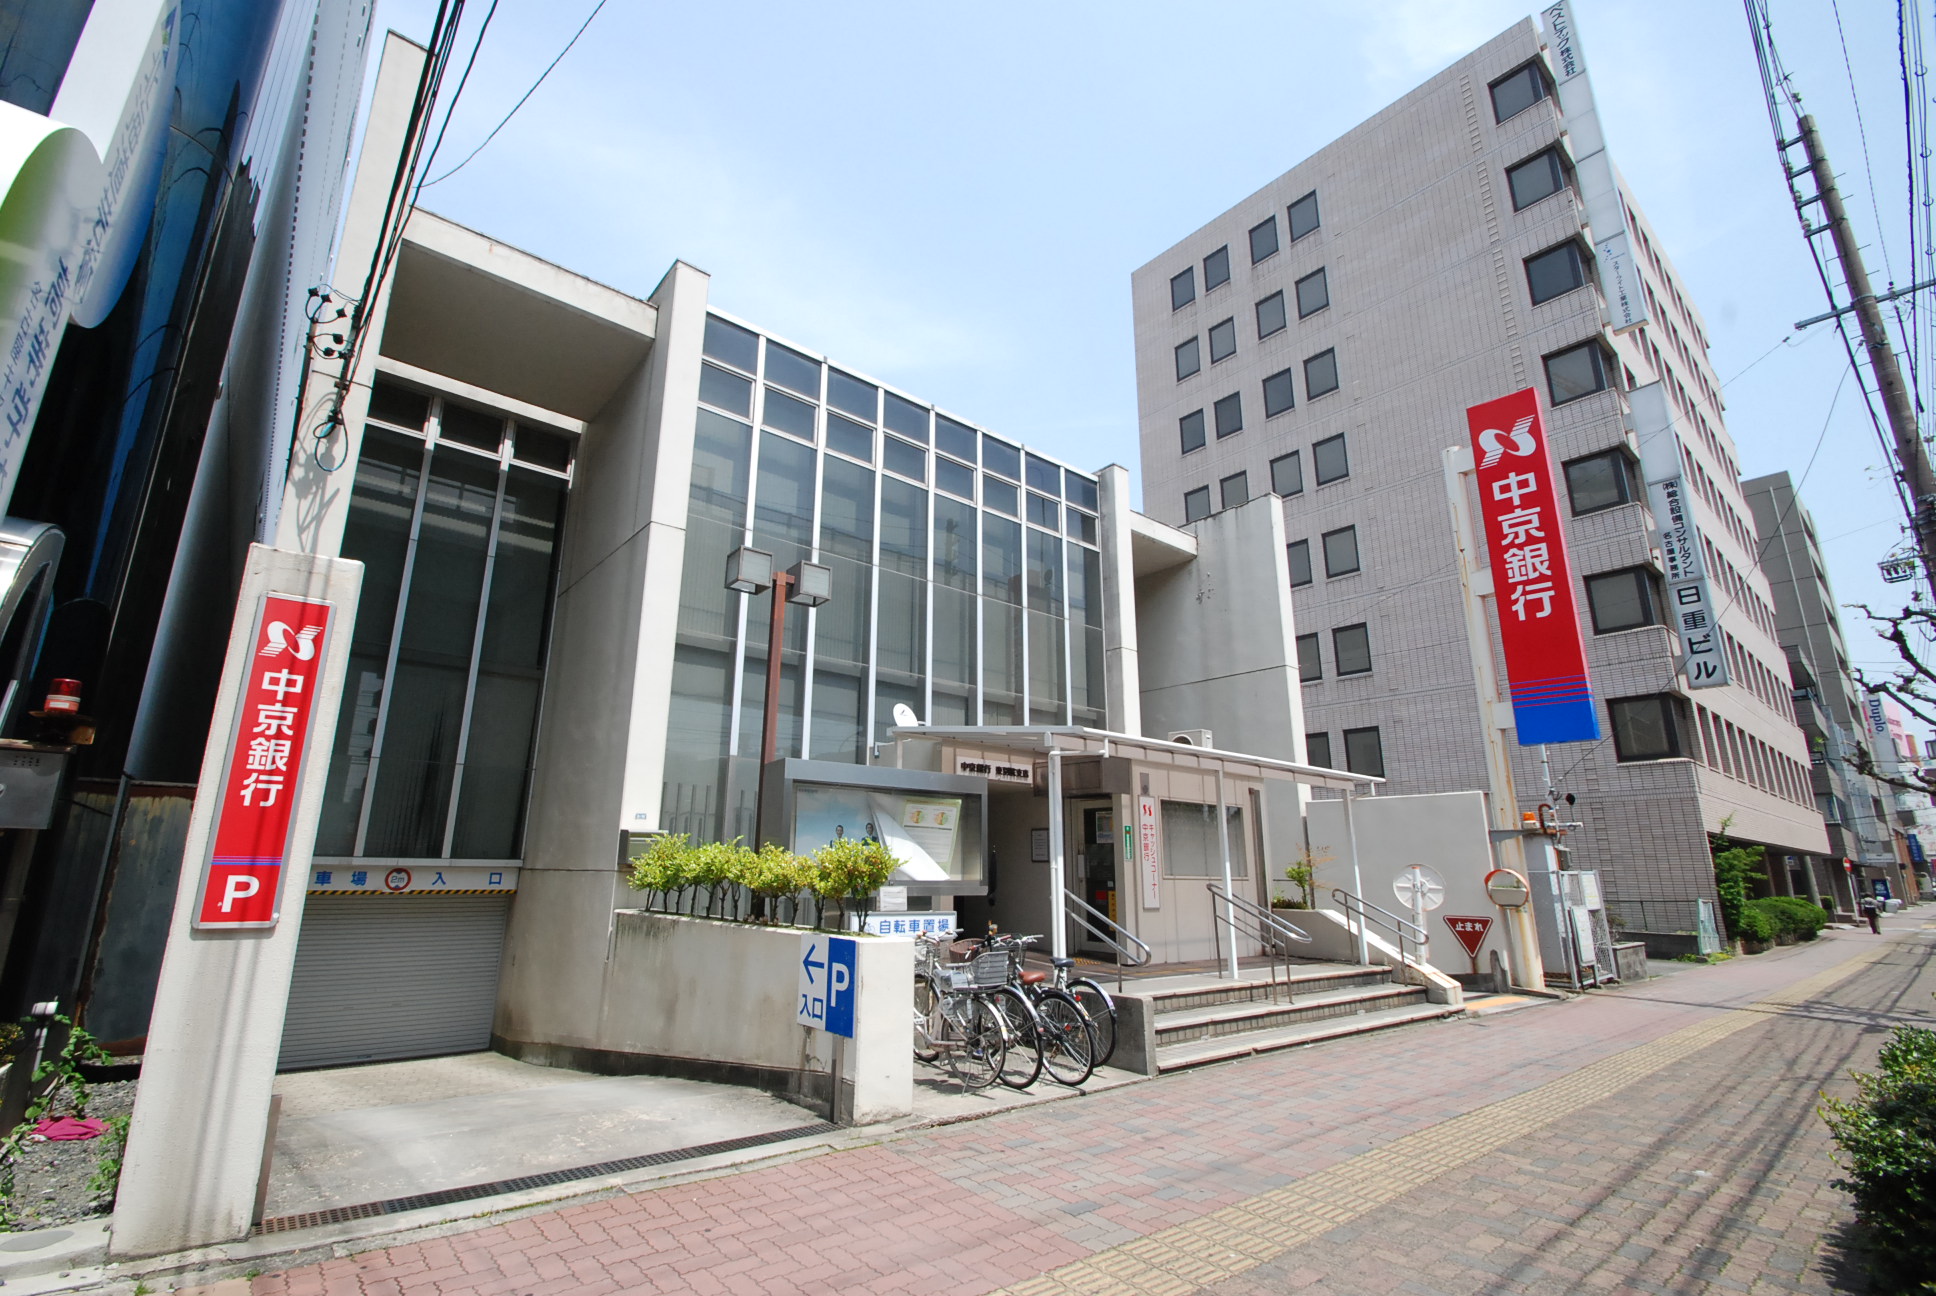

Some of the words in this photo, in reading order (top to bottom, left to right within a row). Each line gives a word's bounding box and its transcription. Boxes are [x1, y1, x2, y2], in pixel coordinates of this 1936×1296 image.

[1491, 471, 1556, 621] 中京銀行
[1663, 532, 1680, 579] 名古屋事務所
[1677, 586, 1718, 680] 日重ビル
[240, 668, 304, 808] 中京銀行
[1142, 823, 1150, 861] 中京銀行
[1149, 824, 1158, 899] キャッシュコーナー
[220, 874, 260, 913] P
[390, 875, 405, 884] 2m
[879, 918, 949, 933] 自転車置場
[1455, 921, 1484, 932] 止まれ
[830, 962, 850, 1008] P
[799, 994, 823, 1021] 入口
